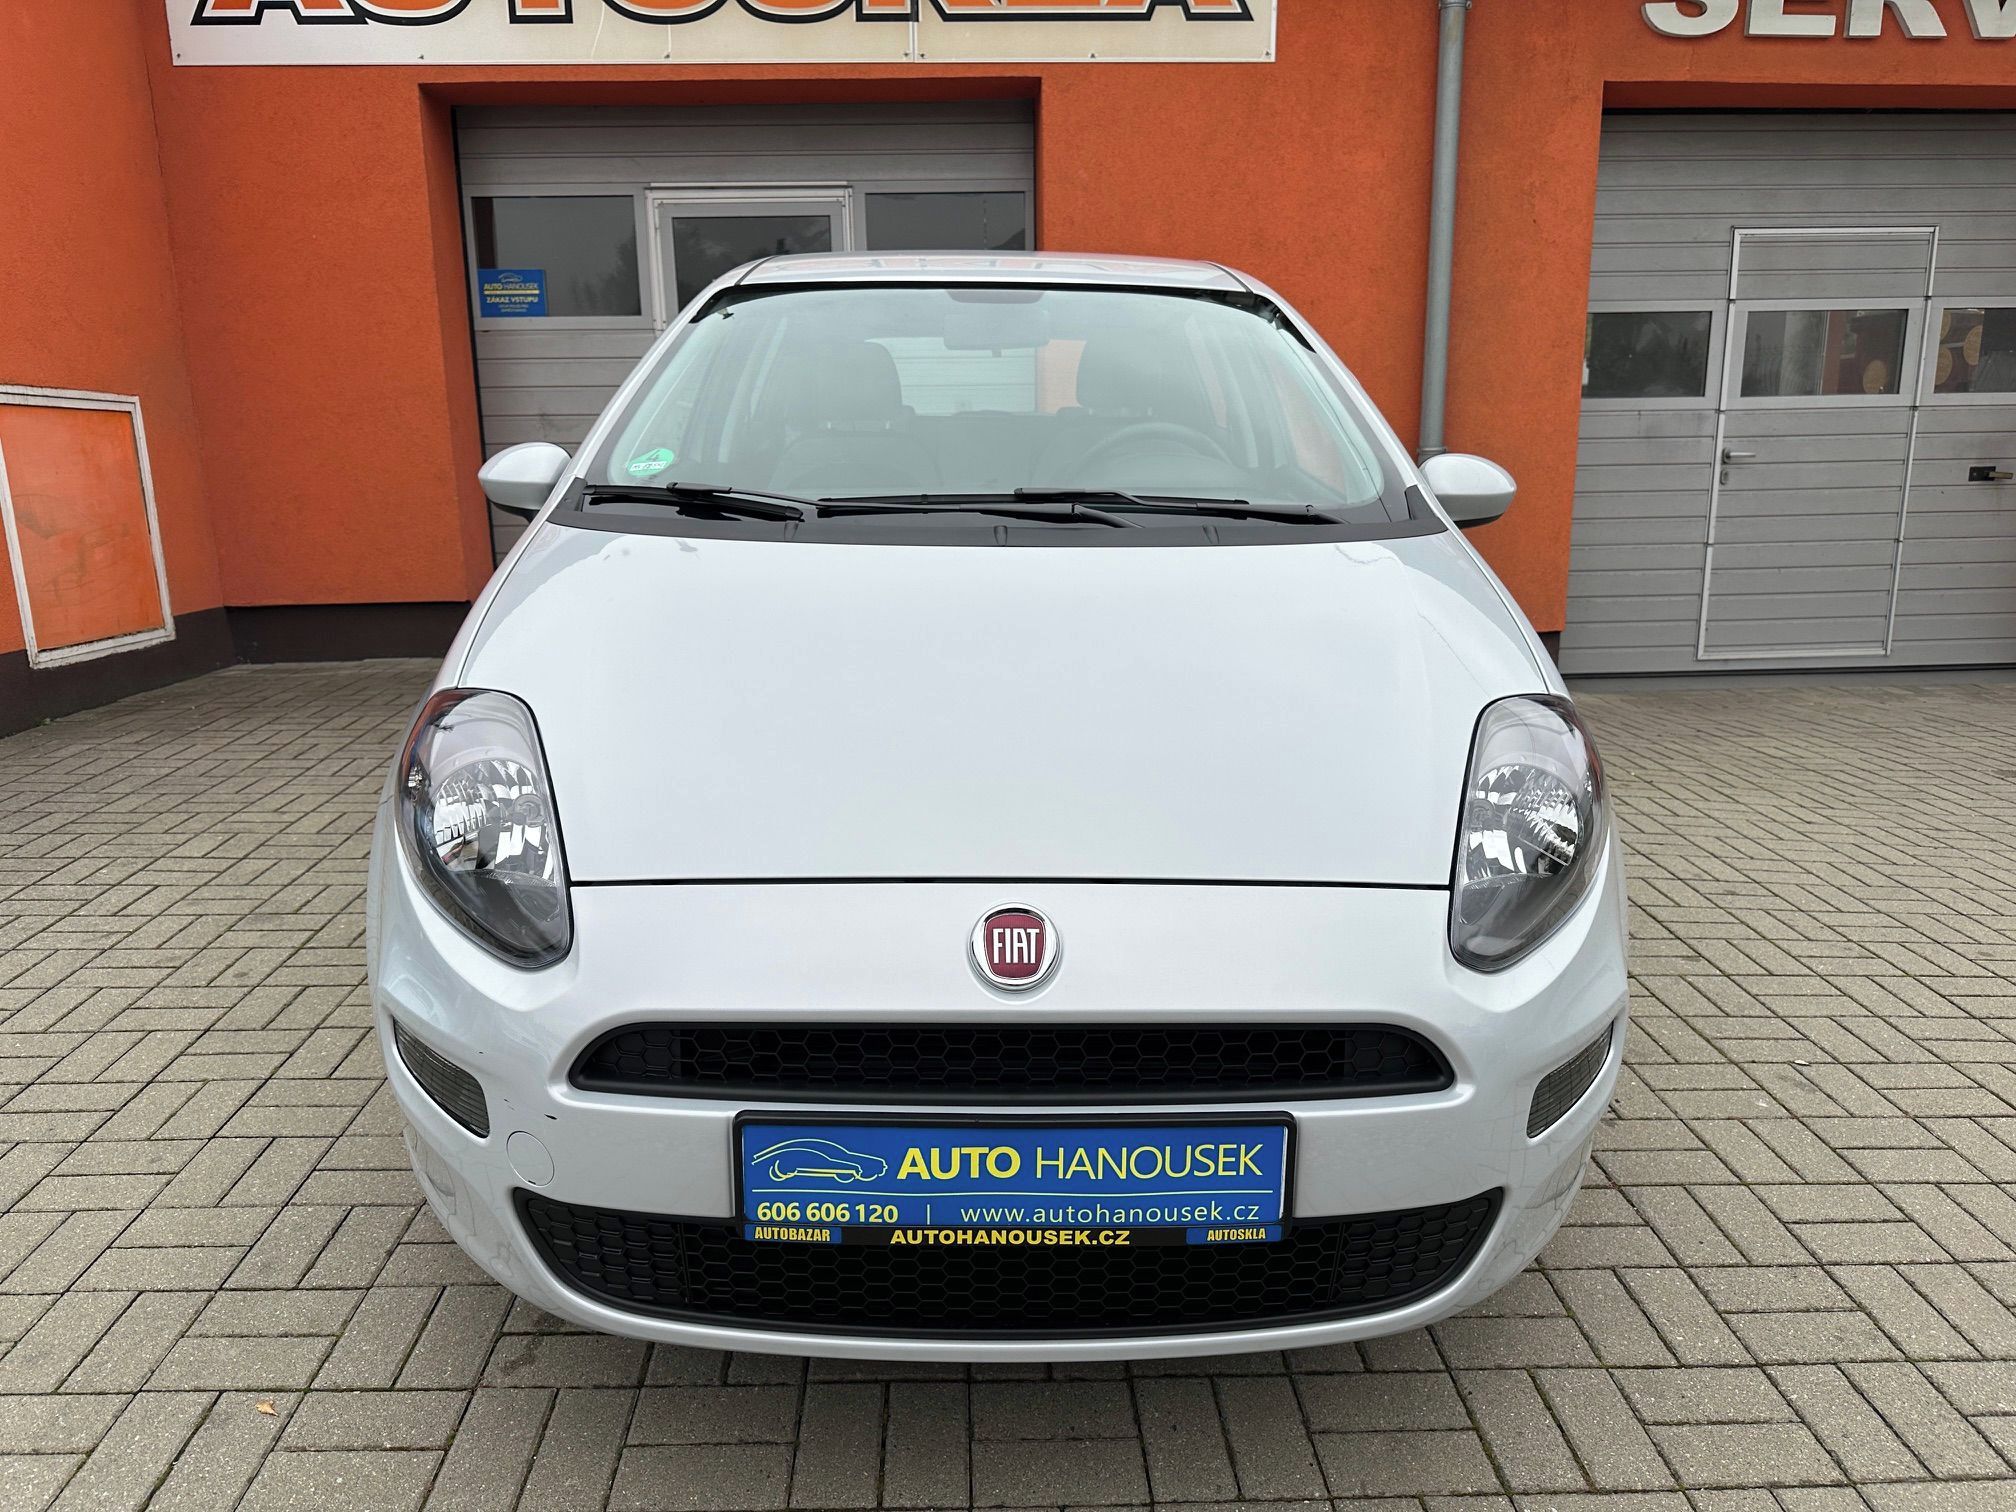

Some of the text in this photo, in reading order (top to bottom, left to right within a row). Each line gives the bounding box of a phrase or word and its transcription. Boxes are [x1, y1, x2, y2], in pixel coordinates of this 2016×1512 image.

[992, 927, 1040, 964] FIAT
[896, 1143, 1264, 1180] AUTO HANOUSEK
[757, 1202, 899, 1223] 606 606 120
[960, 1201, 1260, 1223] www.autohanousek.cz
[754, 1226, 831, 1242] AUTOBAZAR
[890, 1229, 1131, 1245] AUTOHANOUSEK.CZ
[1206, 1227, 1266, 1242] AUTOSKLA
